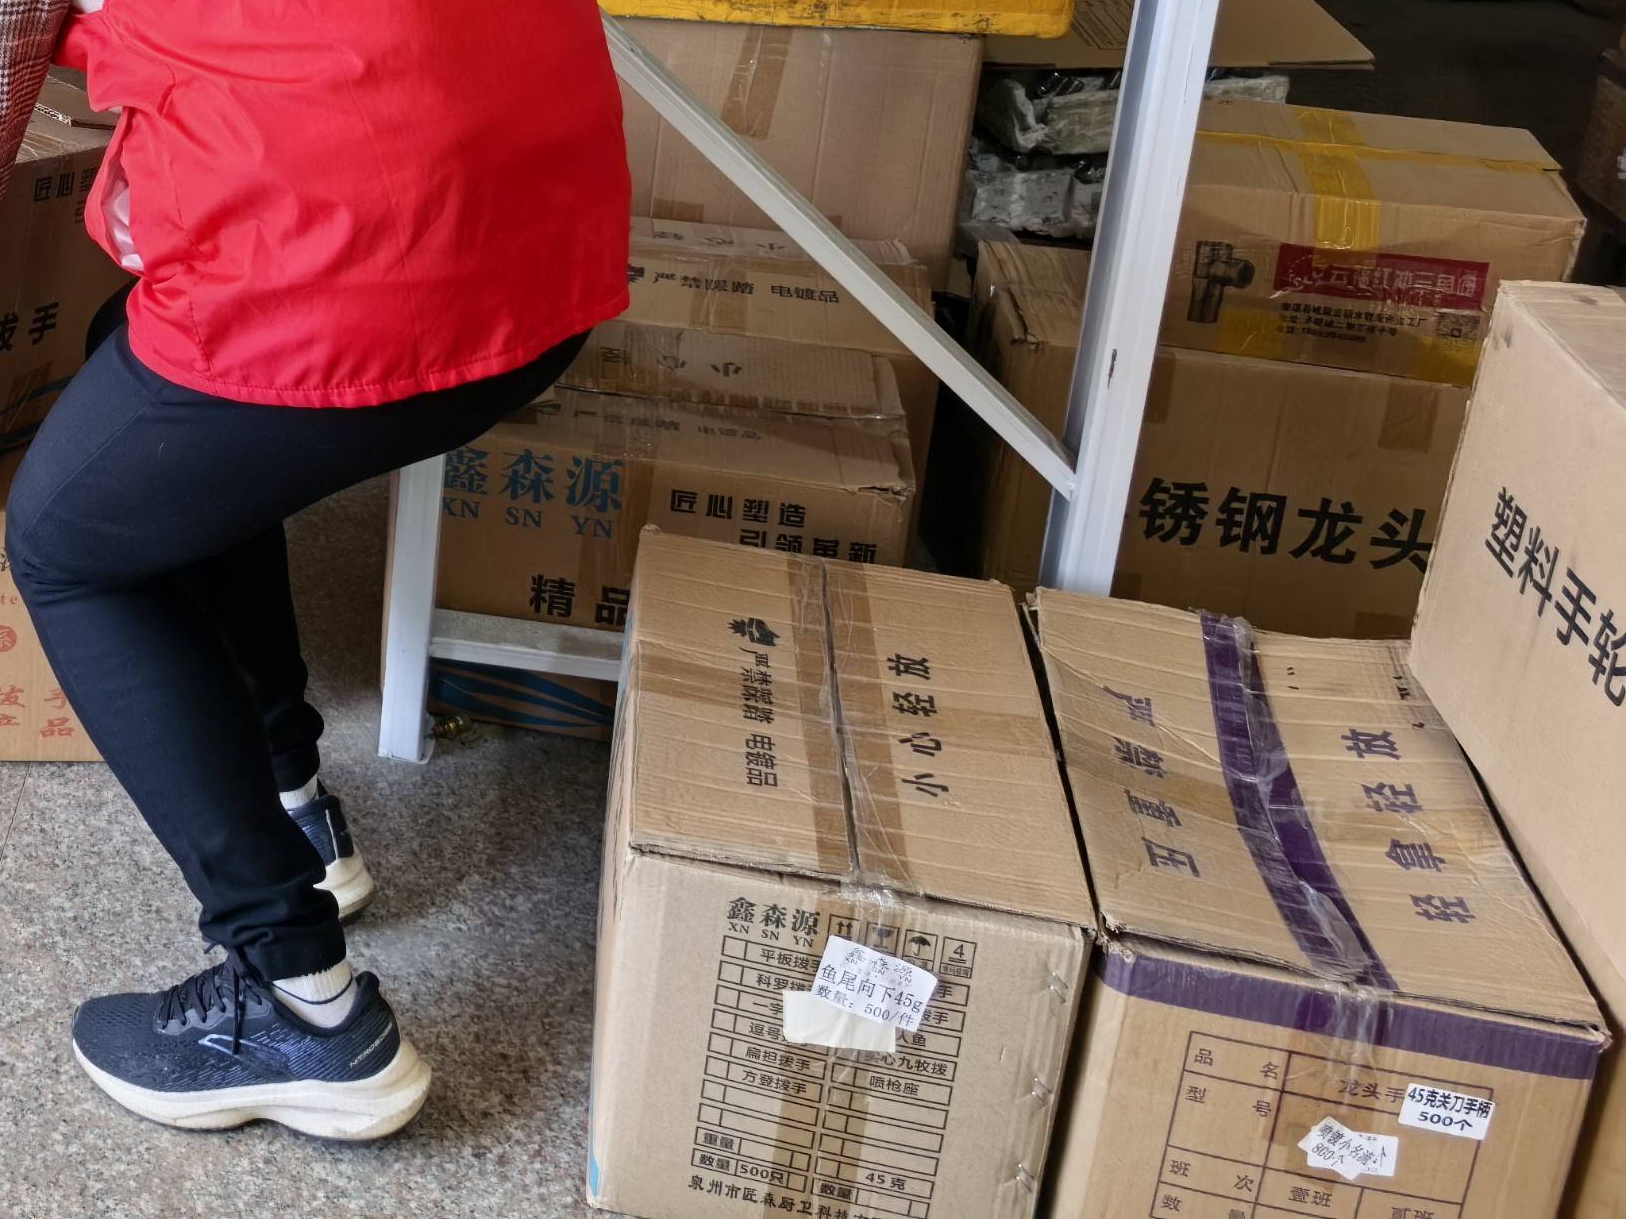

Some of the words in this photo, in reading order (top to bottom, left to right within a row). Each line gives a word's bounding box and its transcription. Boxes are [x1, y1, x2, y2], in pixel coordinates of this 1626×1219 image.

[444, 445, 625, 514] 鑫森源
[505, 507, 543, 530] SN
[571, 516, 614, 539] YN
[670, 488, 807, 529] 匠心塑造
[1139, 477, 1434, 574] 锈钢龙头
[528, 574, 630, 627] 精品
[1485, 485, 1626, 708] 塑料手轮
[1340, 727, 1478, 925] 轻拿轻放
[726, 896, 822, 937] 鑫森源
[727, 922, 750, 935] XN
[760, 928, 780, 942] SN
[793, 935, 815, 949] YN
[953, 943, 965, 958] 4
[755, 973, 812, 991] 科罗拨
[818, 964, 924, 1014] 鱼尾向下45g
[1407, 1086, 1493, 1119] 45克关刀手柄
[1417, 1111, 1473, 1132] 500个
[702, 1131, 735, 1151] 重量
[698, 1152, 732, 1173] 数量
[739, 1162, 785, 1185] 500只
[687, 1174, 884, 1219] 泉州市匠森厨卫科技
[819, 1182, 854, 1201] 数量
